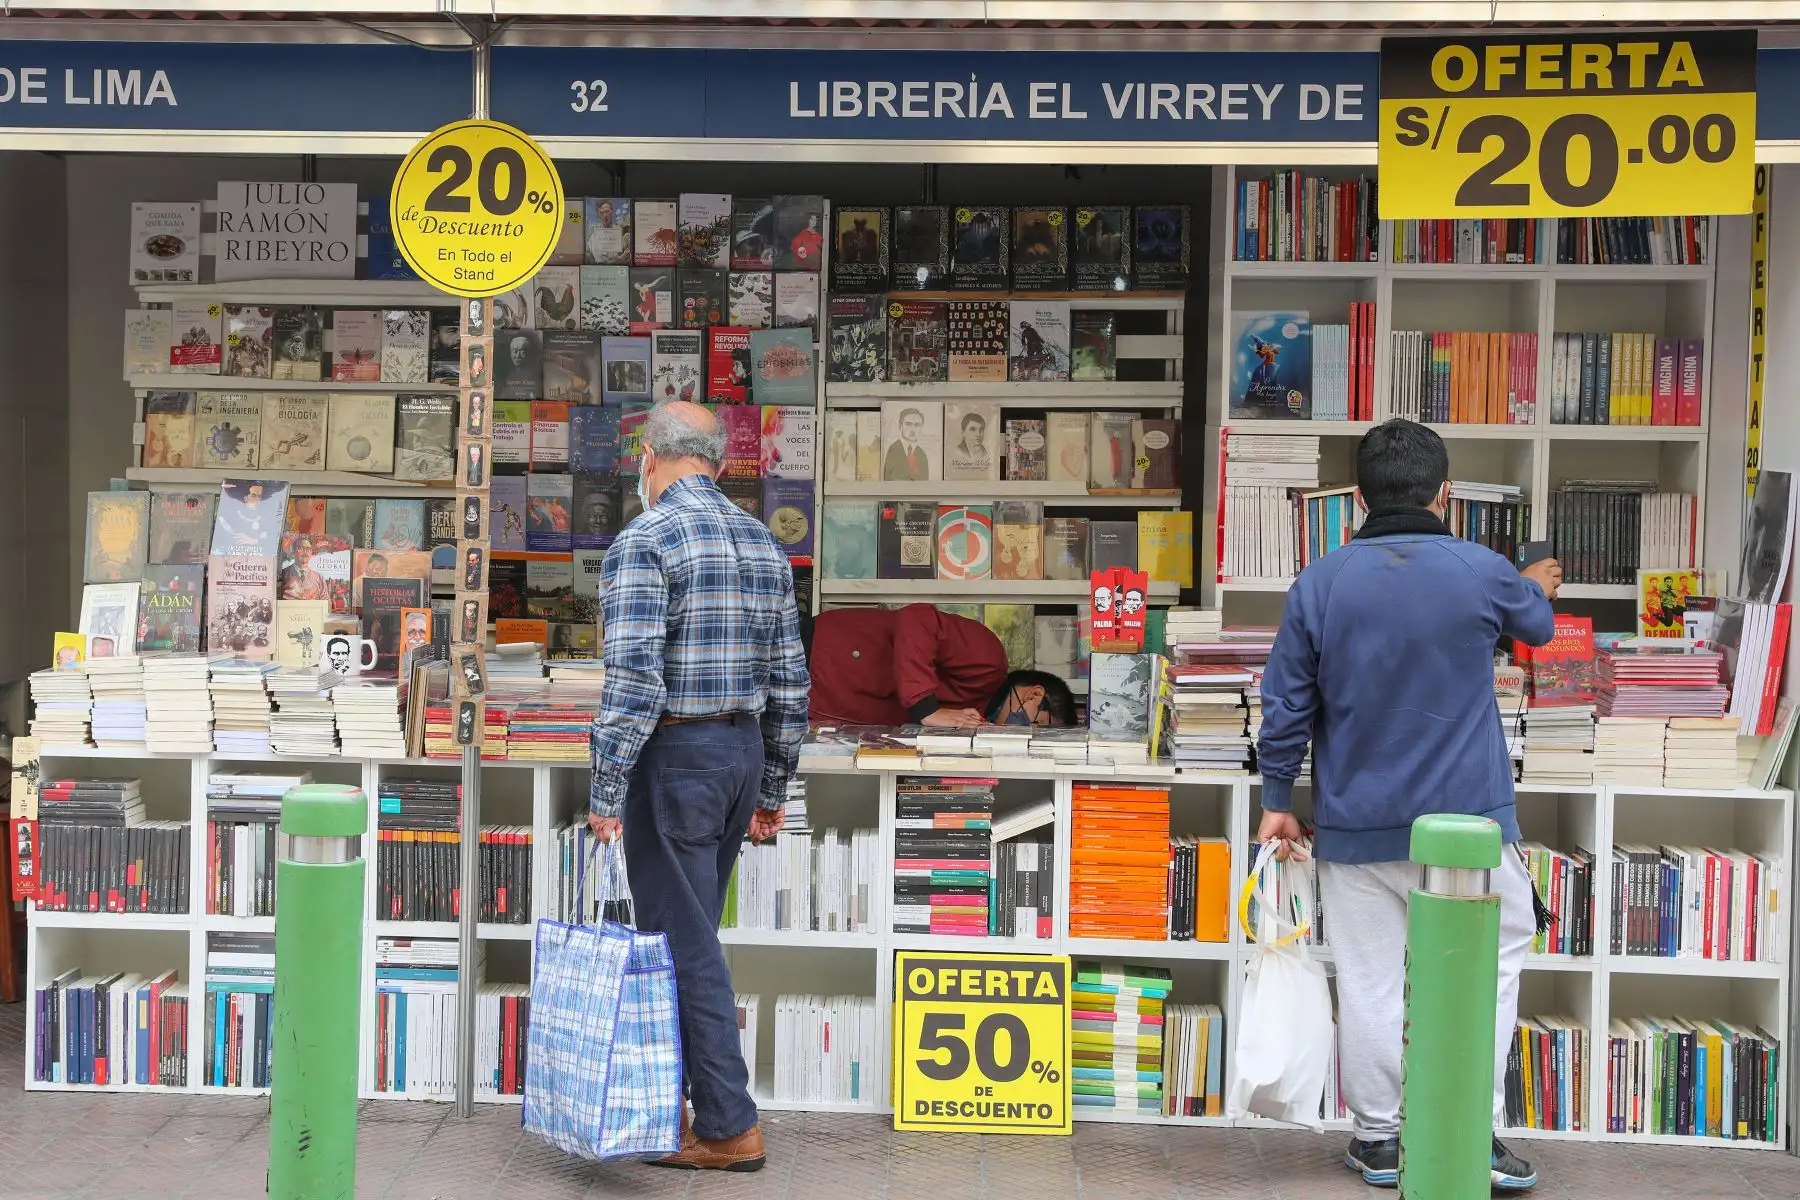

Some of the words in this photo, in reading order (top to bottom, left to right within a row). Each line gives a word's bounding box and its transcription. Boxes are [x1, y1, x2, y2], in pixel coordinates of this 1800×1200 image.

[1431, 41, 1704, 92] OFERTA
[0, 67, 48, 105] DE
[64, 68, 179, 106] LIMA
[570, 80, 609, 113] 32
[789, 72, 1014, 119] LIBRERÍA
[1028, 82, 1088, 120] EL
[1101, 82, 1285, 121] VIRREY
[1299, 84, 1364, 122] DE
[1395, 105, 1451, 150] S/
[1454, 112, 1736, 208] 20.00
[424, 144, 554, 217] 20%
[244, 183, 325, 208] JULIO
[218, 208, 329, 234] RAMÓN
[401, 204, 419, 224] de
[418, 214, 525, 239] Descuento
[224, 241, 349, 262] RIBEYRO
[437, 248, 457, 263] En
[461, 248, 494, 263] Todo
[500, 248, 513, 263] el
[453, 266, 496, 282] Stand
[1658, 355, 1673, 396] IMAGINA
[1683, 355, 1697, 396] IMAGINA
[219, 406, 259, 415] INGENIERÍA
[278, 409, 318, 420] BIOLOGÍA
[1747, 447, 1759, 468] 20
[431, 511, 456, 527] BERN
[431, 526, 456, 539] SANDE
[232, 560, 267, 572] Guerra
[235, 571, 268, 582] Pacífico
[148, 593, 194, 607] ADÁN
[370, 588, 416, 597] HISTORIAS
[373, 597, 412, 605] OCULTAS
[1093, 620, 1113, 628] PALMA
[1554, 628, 1586, 636] UEDAS
[908, 967, 1059, 998] OFERTA
[915, 1012, 1061, 1084] 50%
[974, 1086, 994, 1097] DE
[914, 1100, 1054, 1120] DESCUENTO
